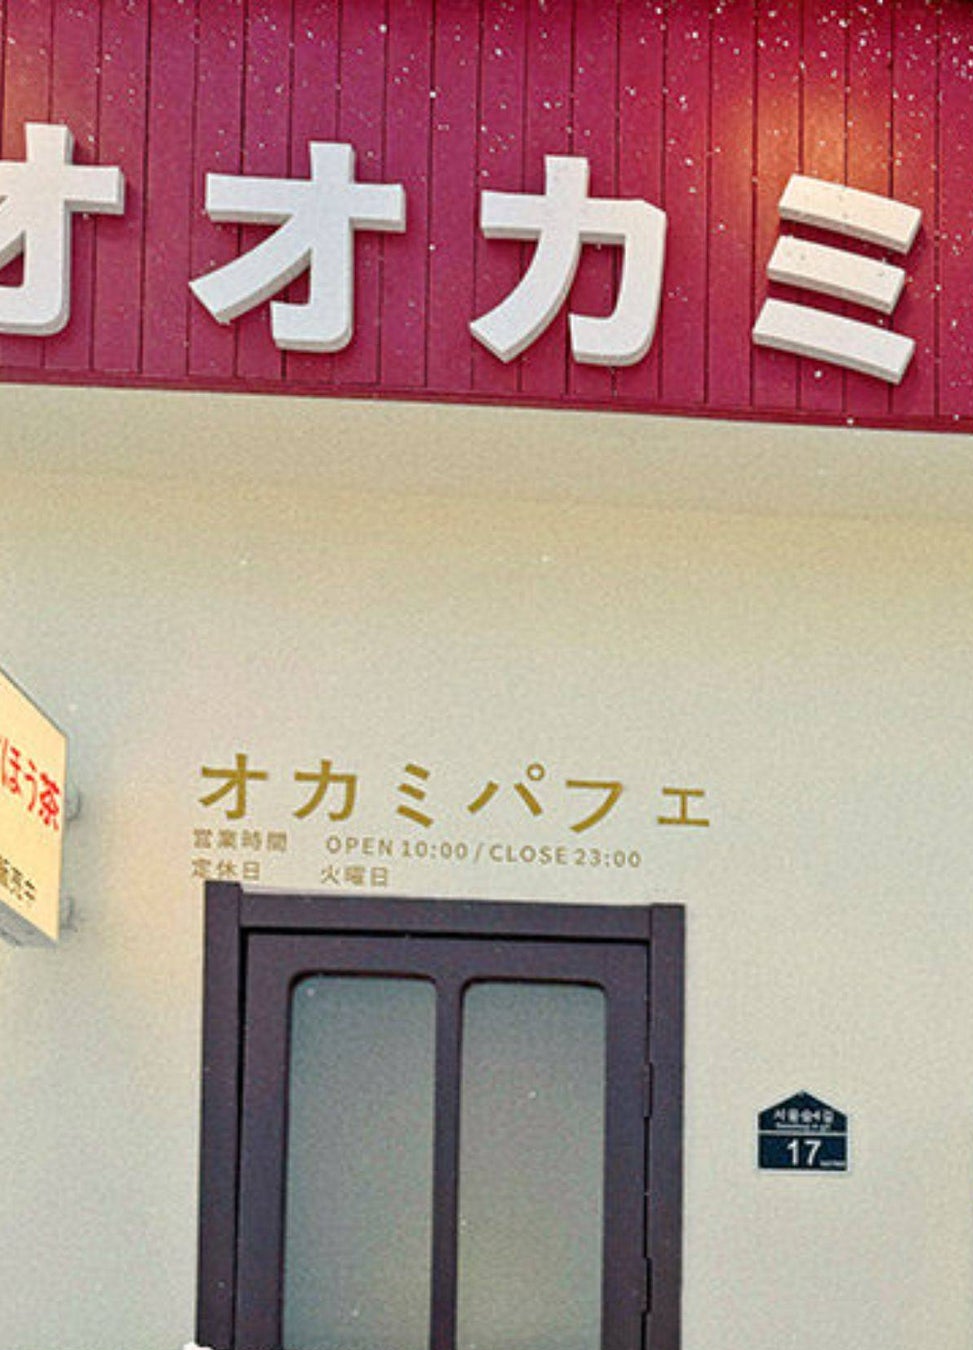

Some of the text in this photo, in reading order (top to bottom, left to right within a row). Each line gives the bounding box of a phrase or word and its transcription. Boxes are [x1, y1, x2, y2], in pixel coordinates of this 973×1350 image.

[199, 753, 711, 834] オカミパフェ
[192, 828, 288, 852] 営業時間
[325, 836, 394, 857] OPEN
[401, 840, 469, 861] 10:00
[489, 844, 568, 865] CLOSE
[573, 848, 643, 869] 23:00
[191, 857, 391, 887] 定休日 火曜日
[786, 1138, 822, 1166] 17
